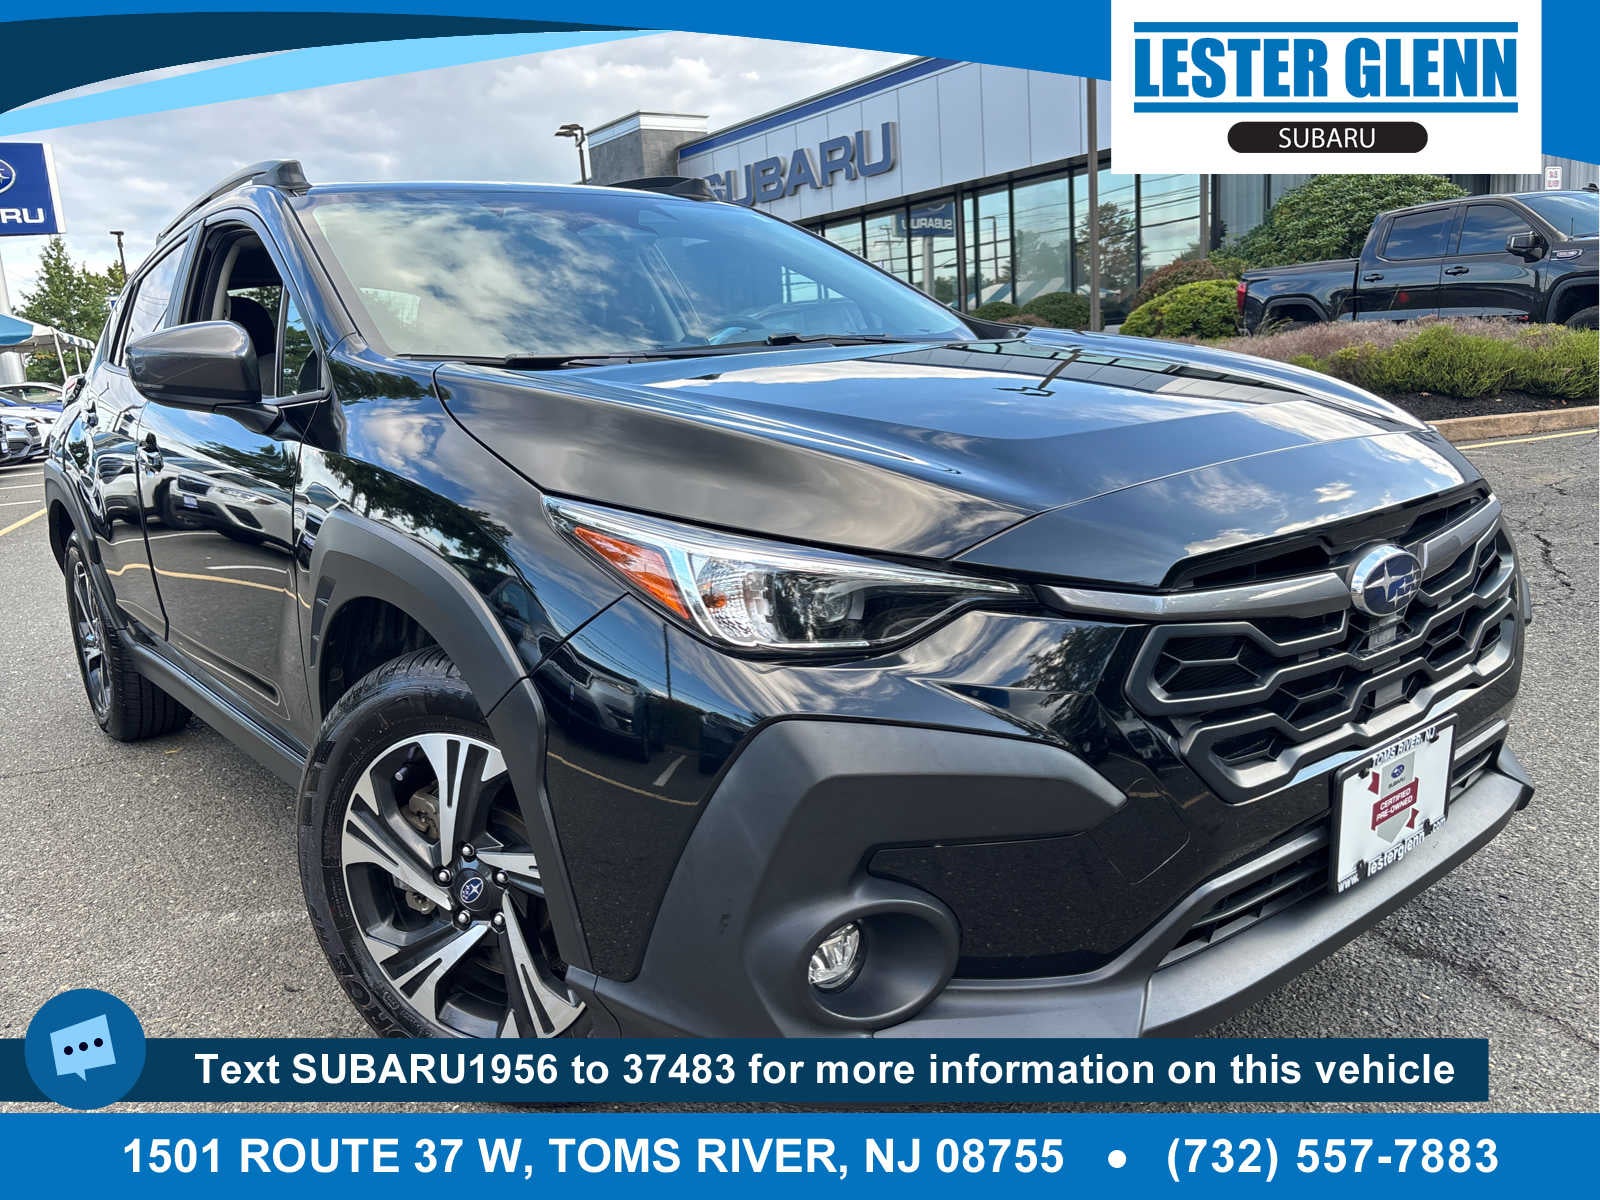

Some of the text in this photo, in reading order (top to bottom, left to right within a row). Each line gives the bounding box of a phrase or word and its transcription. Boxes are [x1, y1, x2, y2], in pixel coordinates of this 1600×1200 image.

[1374, 746, 1397, 767] TOMS
[1375, 795, 1413, 822] PRE-OWNED
[1380, 787, 1412, 811] CERTIFIED
